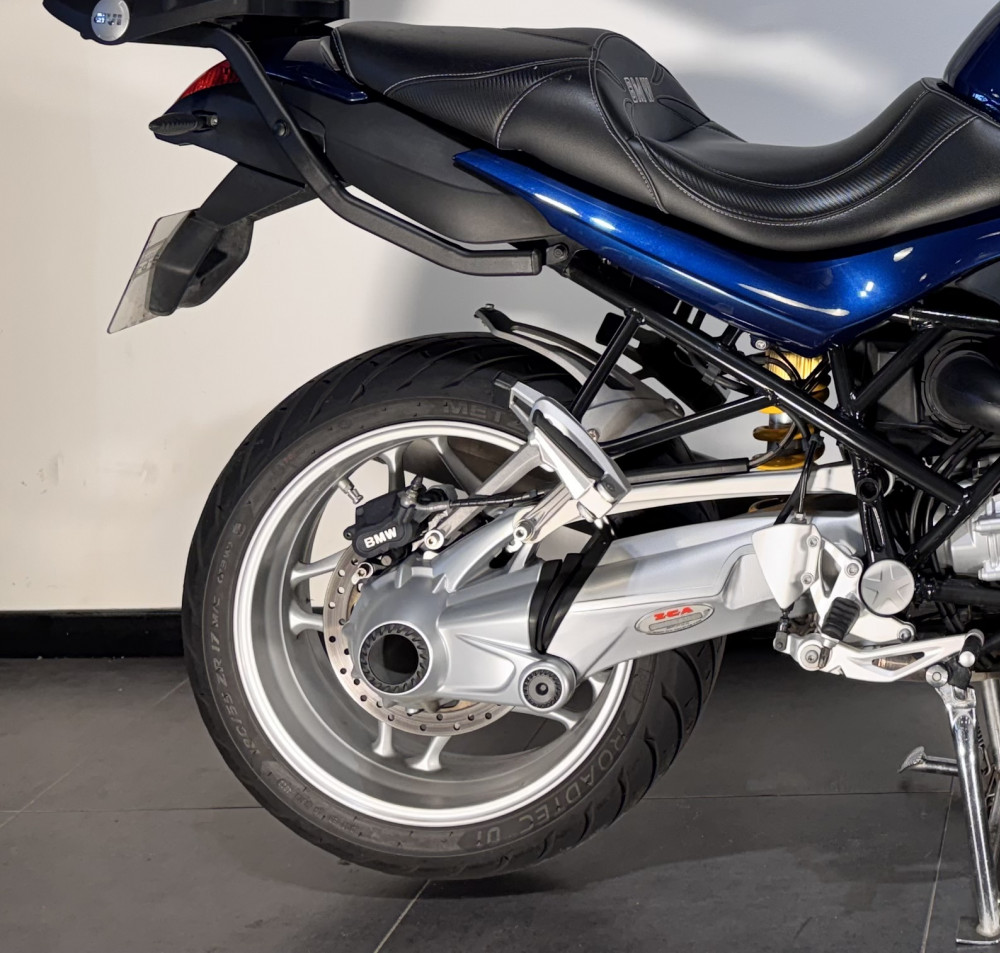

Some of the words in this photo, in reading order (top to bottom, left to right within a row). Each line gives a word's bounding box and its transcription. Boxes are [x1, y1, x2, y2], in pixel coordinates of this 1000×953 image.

[624, 77, 655, 103] BMW
[363, 526, 397, 549] BMW
[213, 658, 229, 688] ZR
[518, 727, 627, 834] ROADTEC
